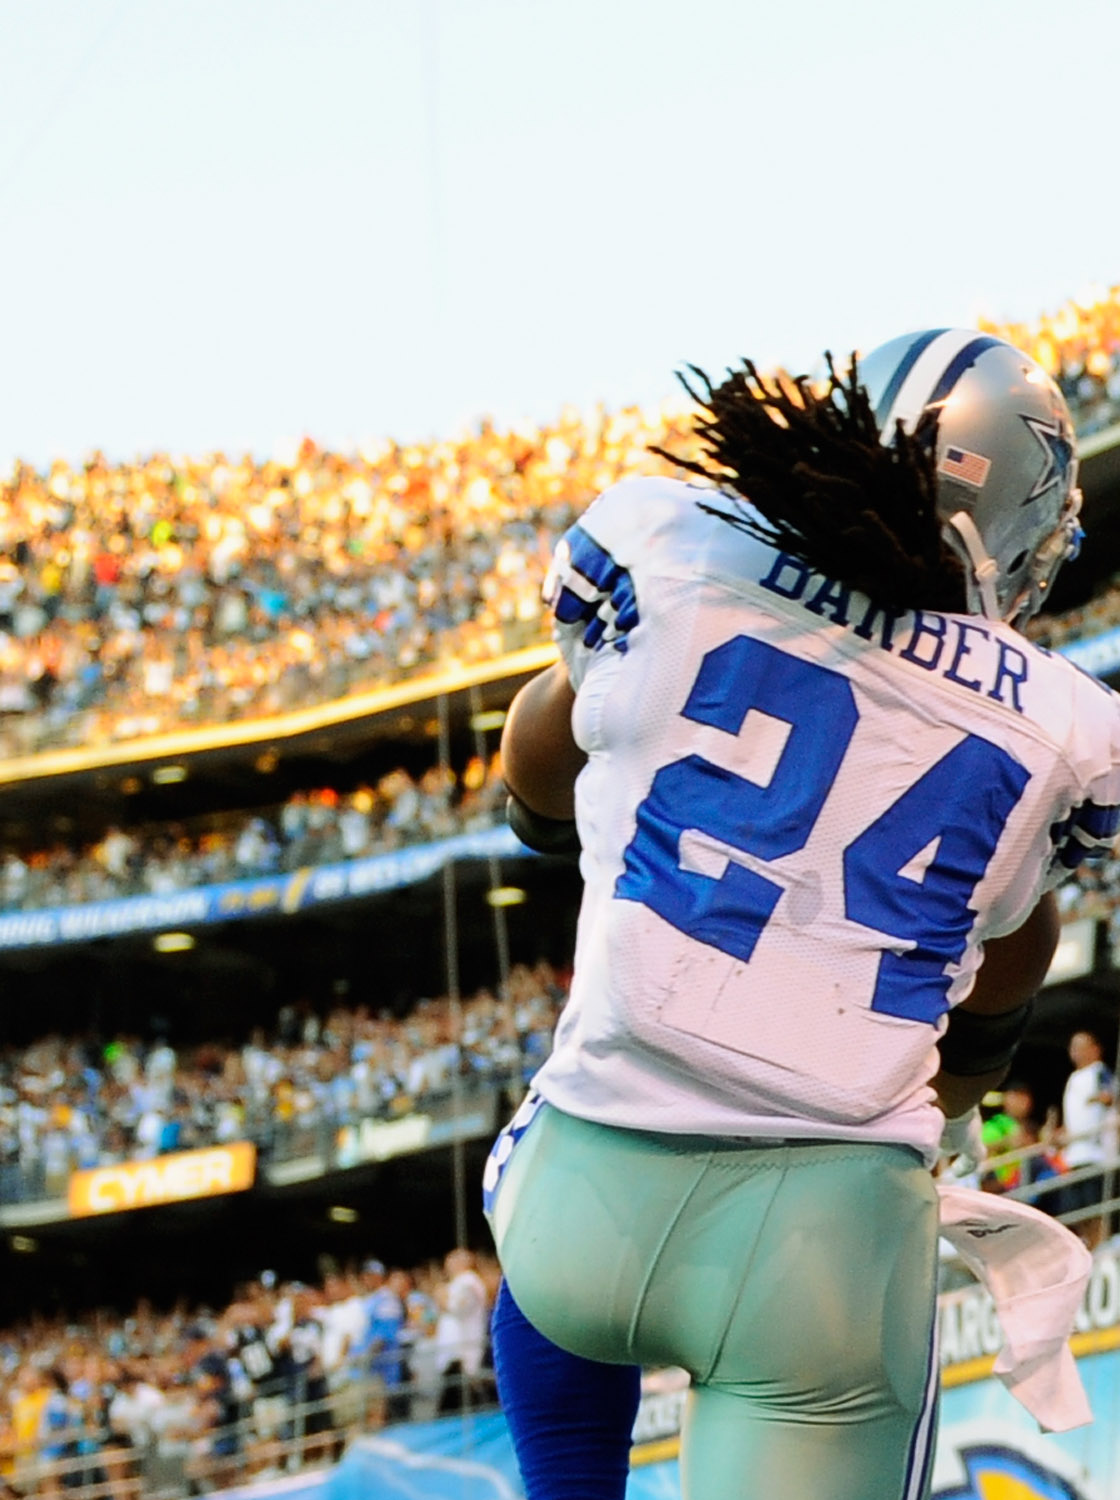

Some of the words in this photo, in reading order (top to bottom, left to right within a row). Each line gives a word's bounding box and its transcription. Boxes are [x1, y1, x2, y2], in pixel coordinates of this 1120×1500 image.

[759, 551, 1029, 714] BARBER
[614, 634, 1032, 1031] 24
[89, 1151, 233, 1212] CYMER
